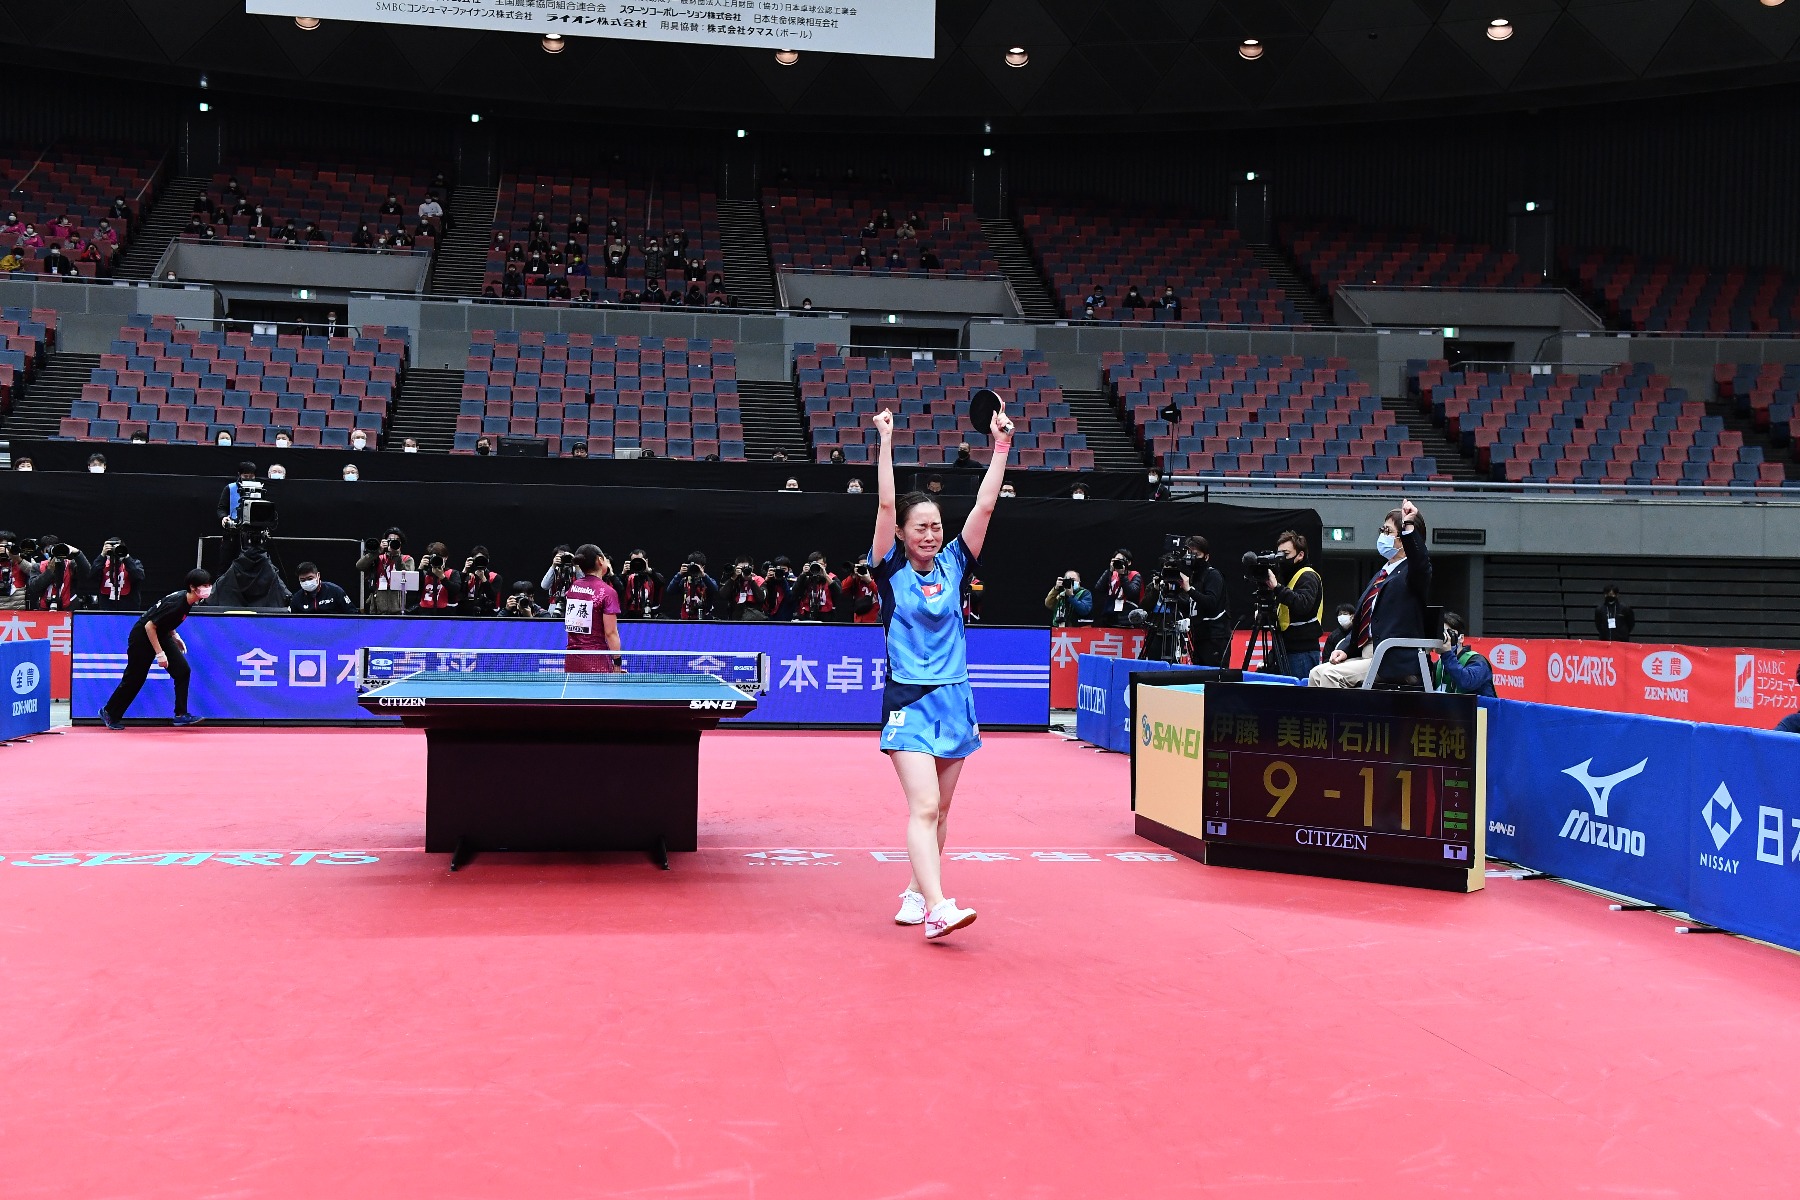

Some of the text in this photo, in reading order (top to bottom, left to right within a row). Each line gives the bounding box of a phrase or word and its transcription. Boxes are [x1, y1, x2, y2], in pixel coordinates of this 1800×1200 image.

[546, 13, 648, 29] ライオン株式会社
[619, 5, 741, 22] スターツコーポレーション株式会社
[753, 14, 839, 29] 日本生命保険相互会社
[1564, 655, 1617, 687] STARTS
[1651, 657, 1682, 676] 全農
[1757, 659, 1786, 676] SMBC
[1644, 686, 1689, 703] ZEN-NOH
[1757, 676, 1800, 692] コンシューマー
[379, 697, 427, 707] CITIZEN
[1078, 684, 1107, 716] CITIZEN
[1756, 692, 1798, 709] ファイナンス
[1277, 715, 1328, 750] 美誠
[1338, 721, 1390, 755] 石川
[1410, 723, 1466, 760] 佳純
[1263, 761, 1298, 818] 9
[1358, 767, 1412, 831] 11
[1295, 828, 1368, 851] CITIZEN
[1558, 809, 1646, 858] MIZUNO
[1699, 852, 1740, 875] NISSAY
